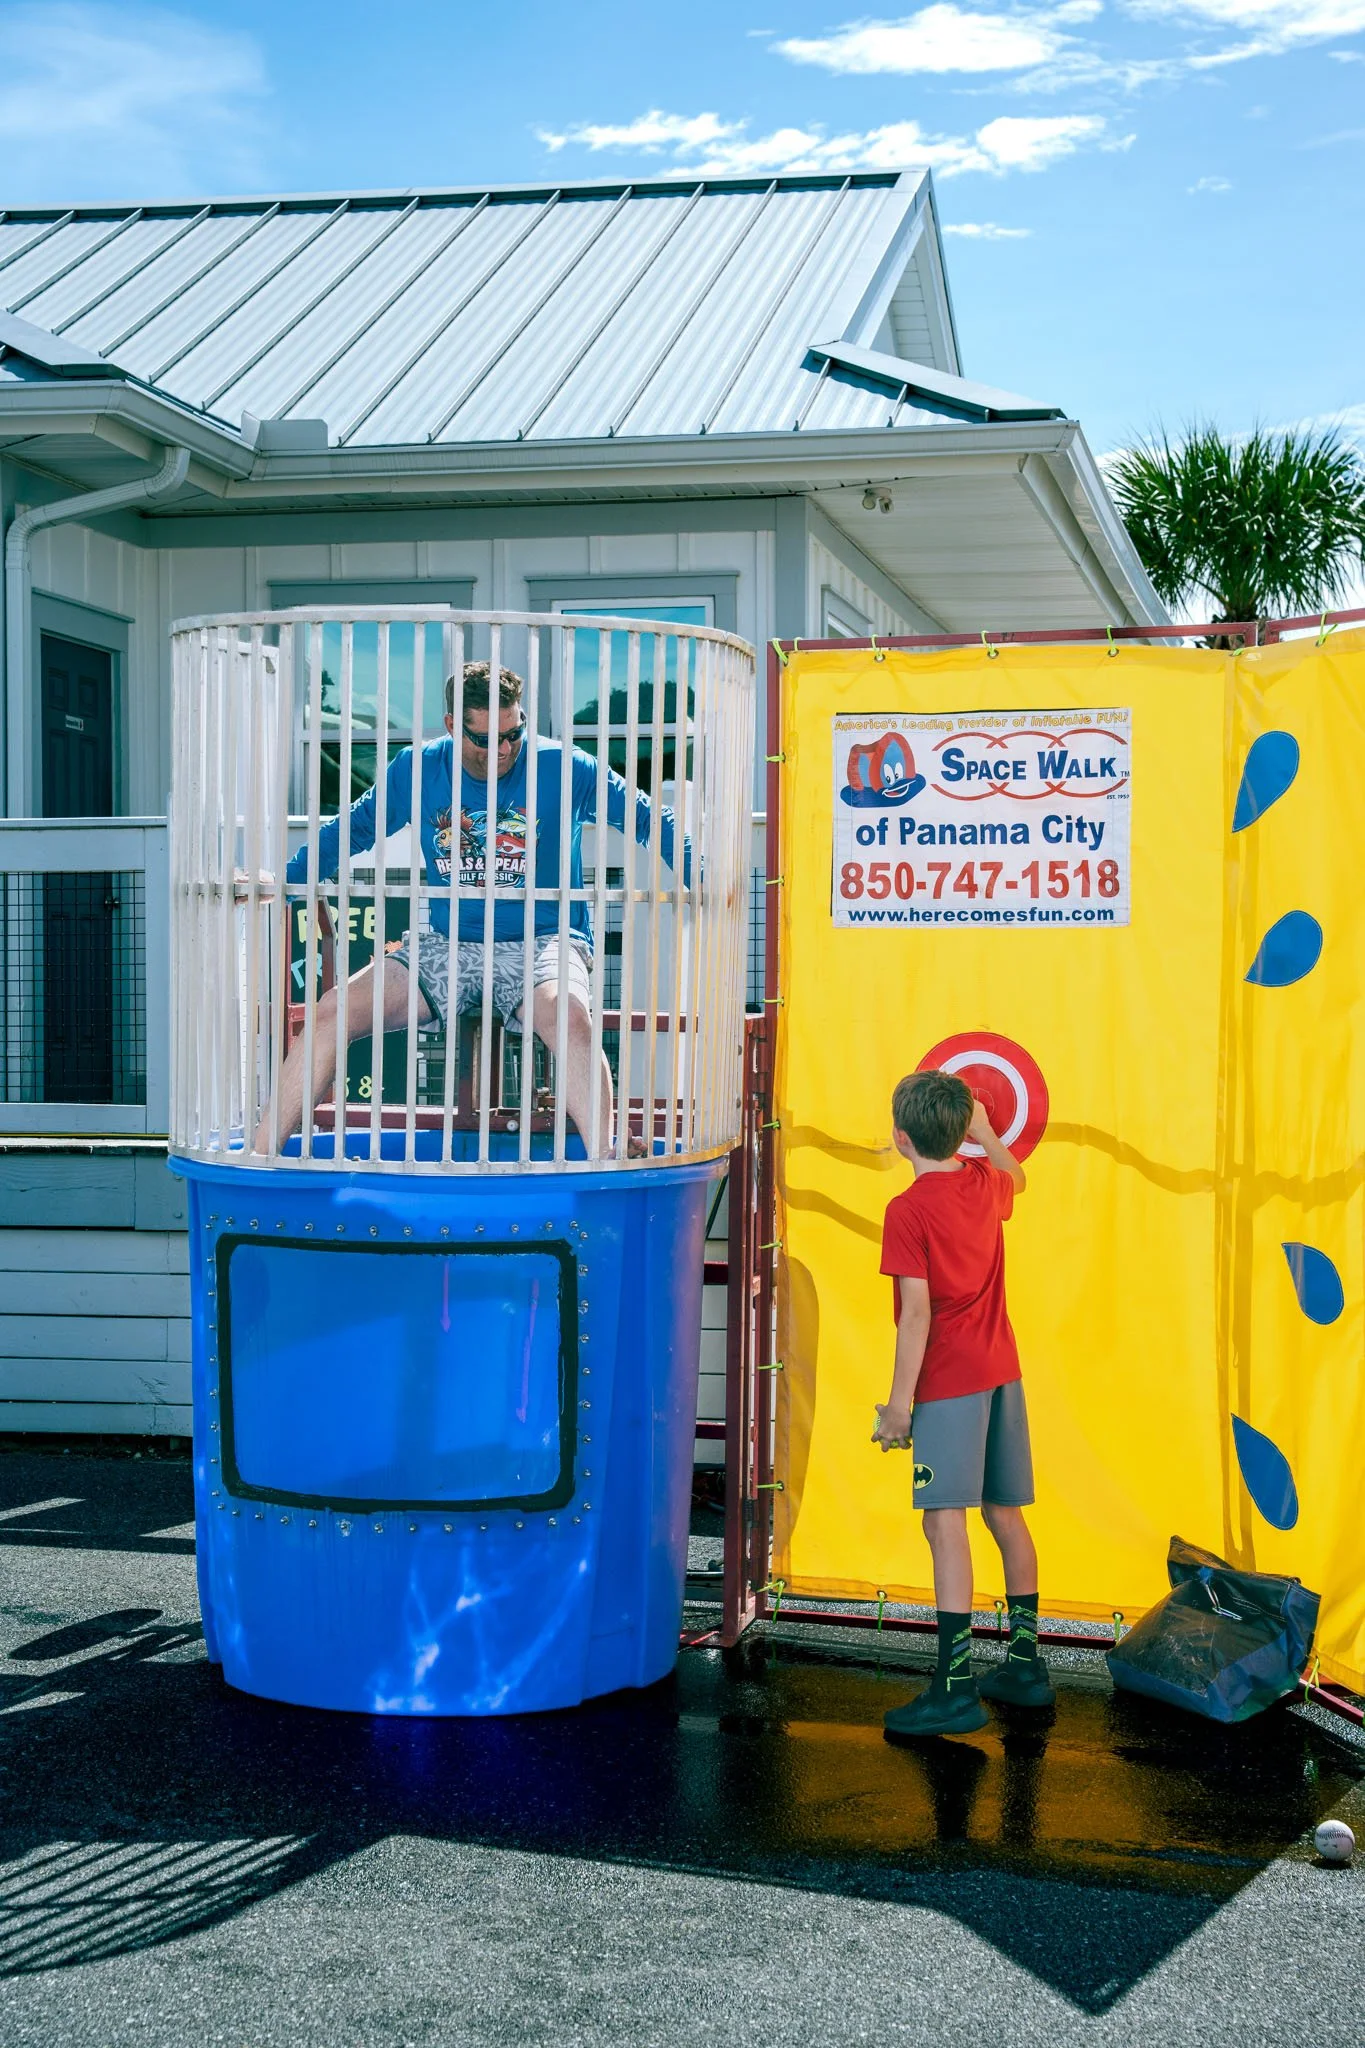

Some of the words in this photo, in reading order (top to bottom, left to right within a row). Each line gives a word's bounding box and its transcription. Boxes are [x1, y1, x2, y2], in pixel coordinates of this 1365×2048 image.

[834, 719, 898, 731] America's
[902, 718, 954, 731] Leading
[958, 716, 1008, 729] Provider
[1012, 716, 1026, 727] of
[1031, 712, 1093, 727] Inflatable
[1096, 711, 1129, 724] FUN!
[941, 748, 1027, 782] SPACE
[1037, 750, 1117, 779] WALK
[855, 817, 889, 846] of
[900, 816, 1030, 846] Panama
[1041, 814, 1105, 851] City
[435, 856, 474, 875] RELS
[477, 872, 514, 882] CSSIC
[840, 859, 1121, 901] 850-747-1518
[847, 906, 1115, 922] www.herecomesfun.com
